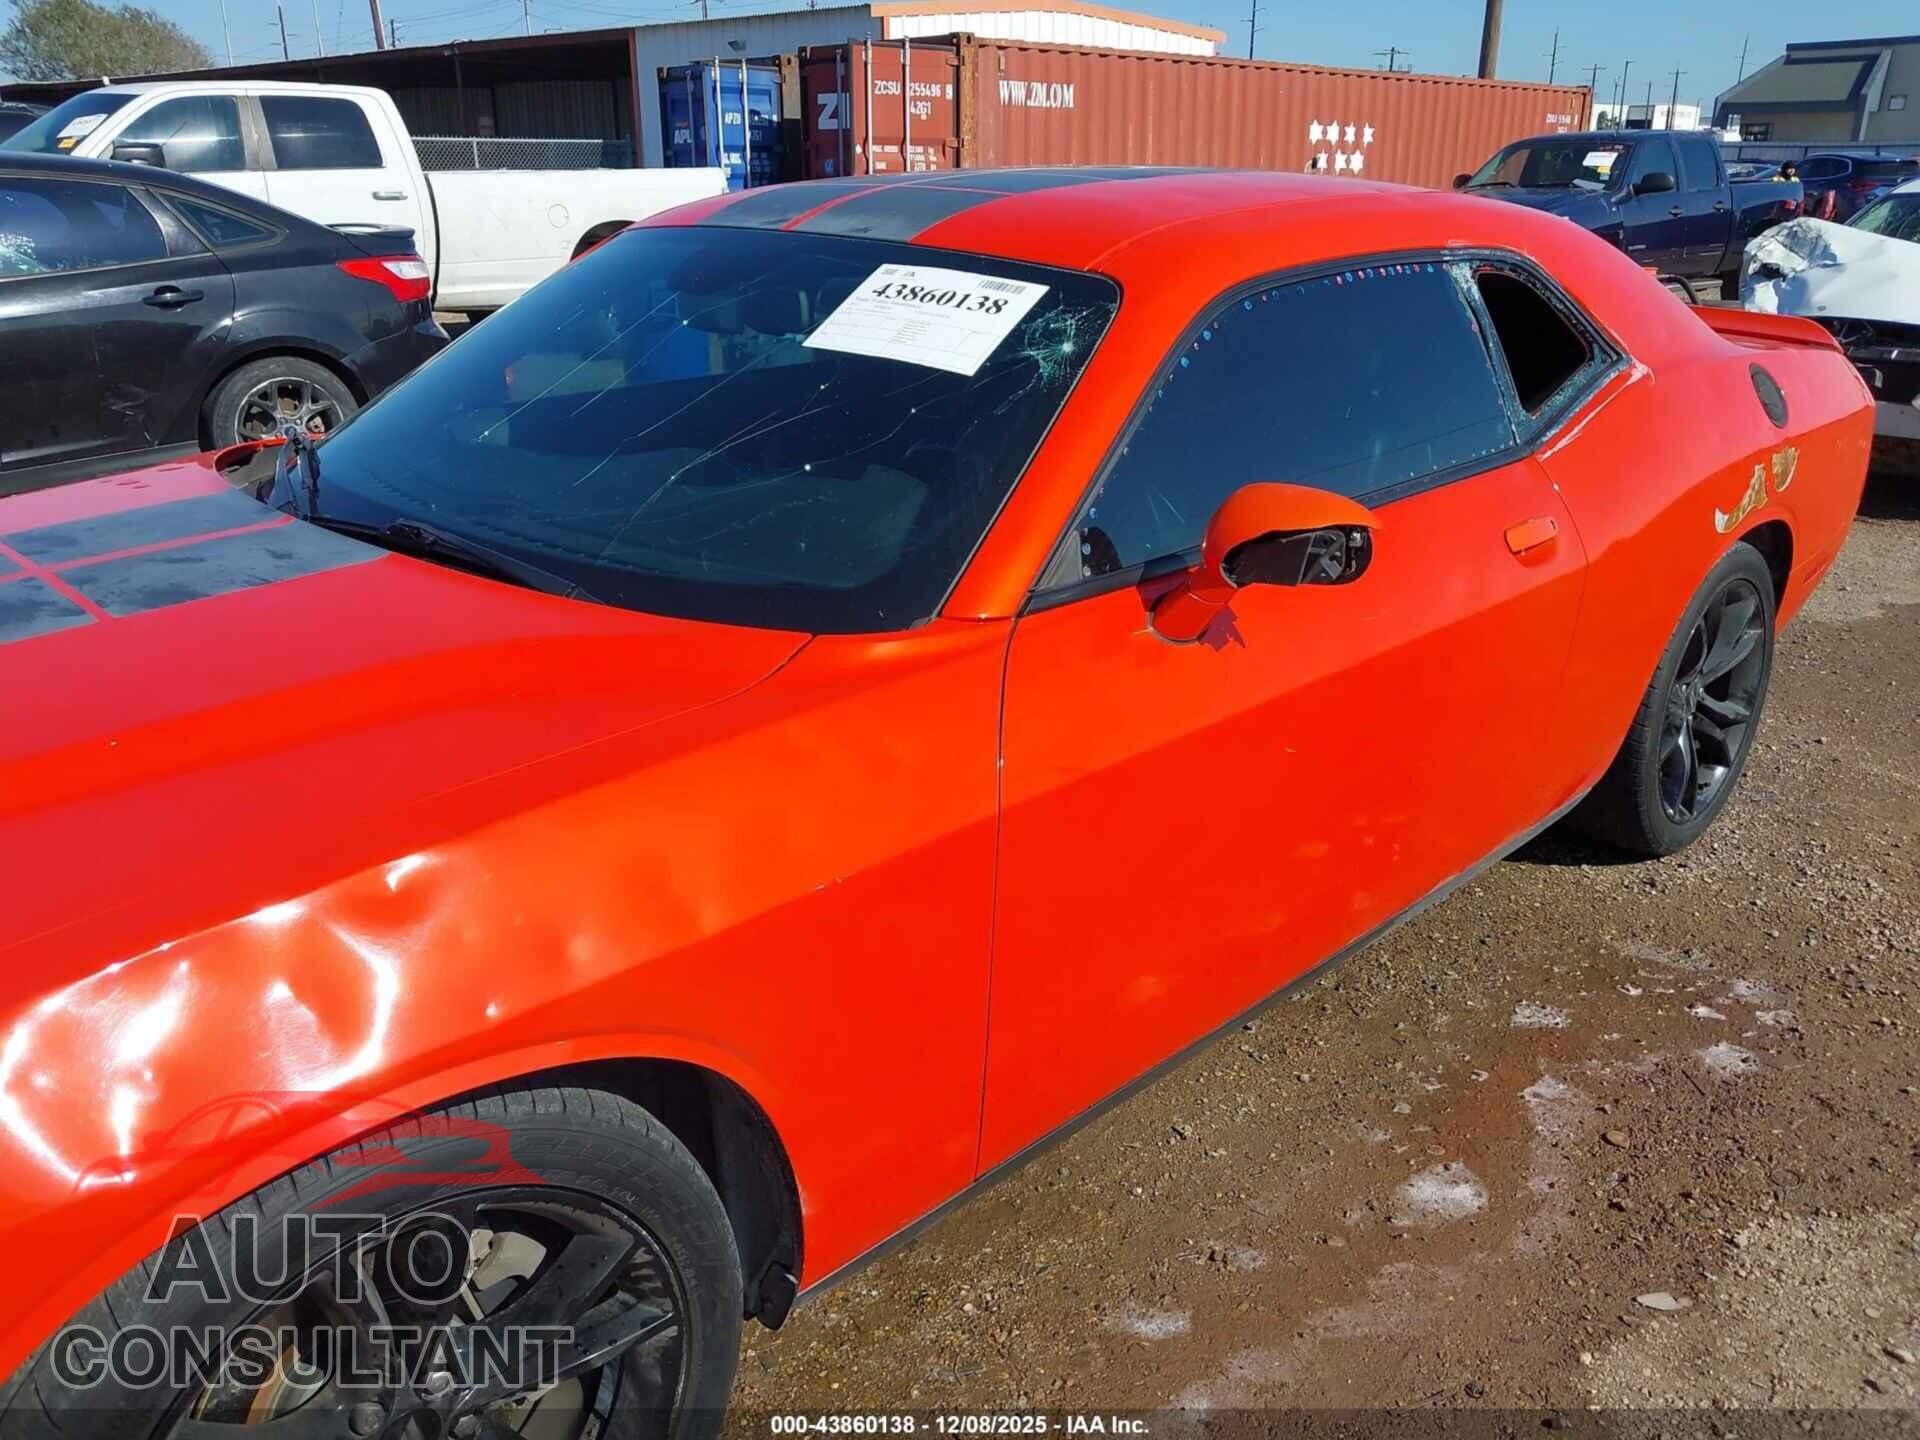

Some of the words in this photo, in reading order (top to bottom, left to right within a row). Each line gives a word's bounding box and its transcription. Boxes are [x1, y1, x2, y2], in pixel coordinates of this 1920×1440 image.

[874, 80, 900, 95] ZCSU
[910, 82, 941, 97] 255496
[910, 100, 931, 115] 42G1
[674, 128, 693, 144] APL
[871, 282, 1008, 315] 43860138
